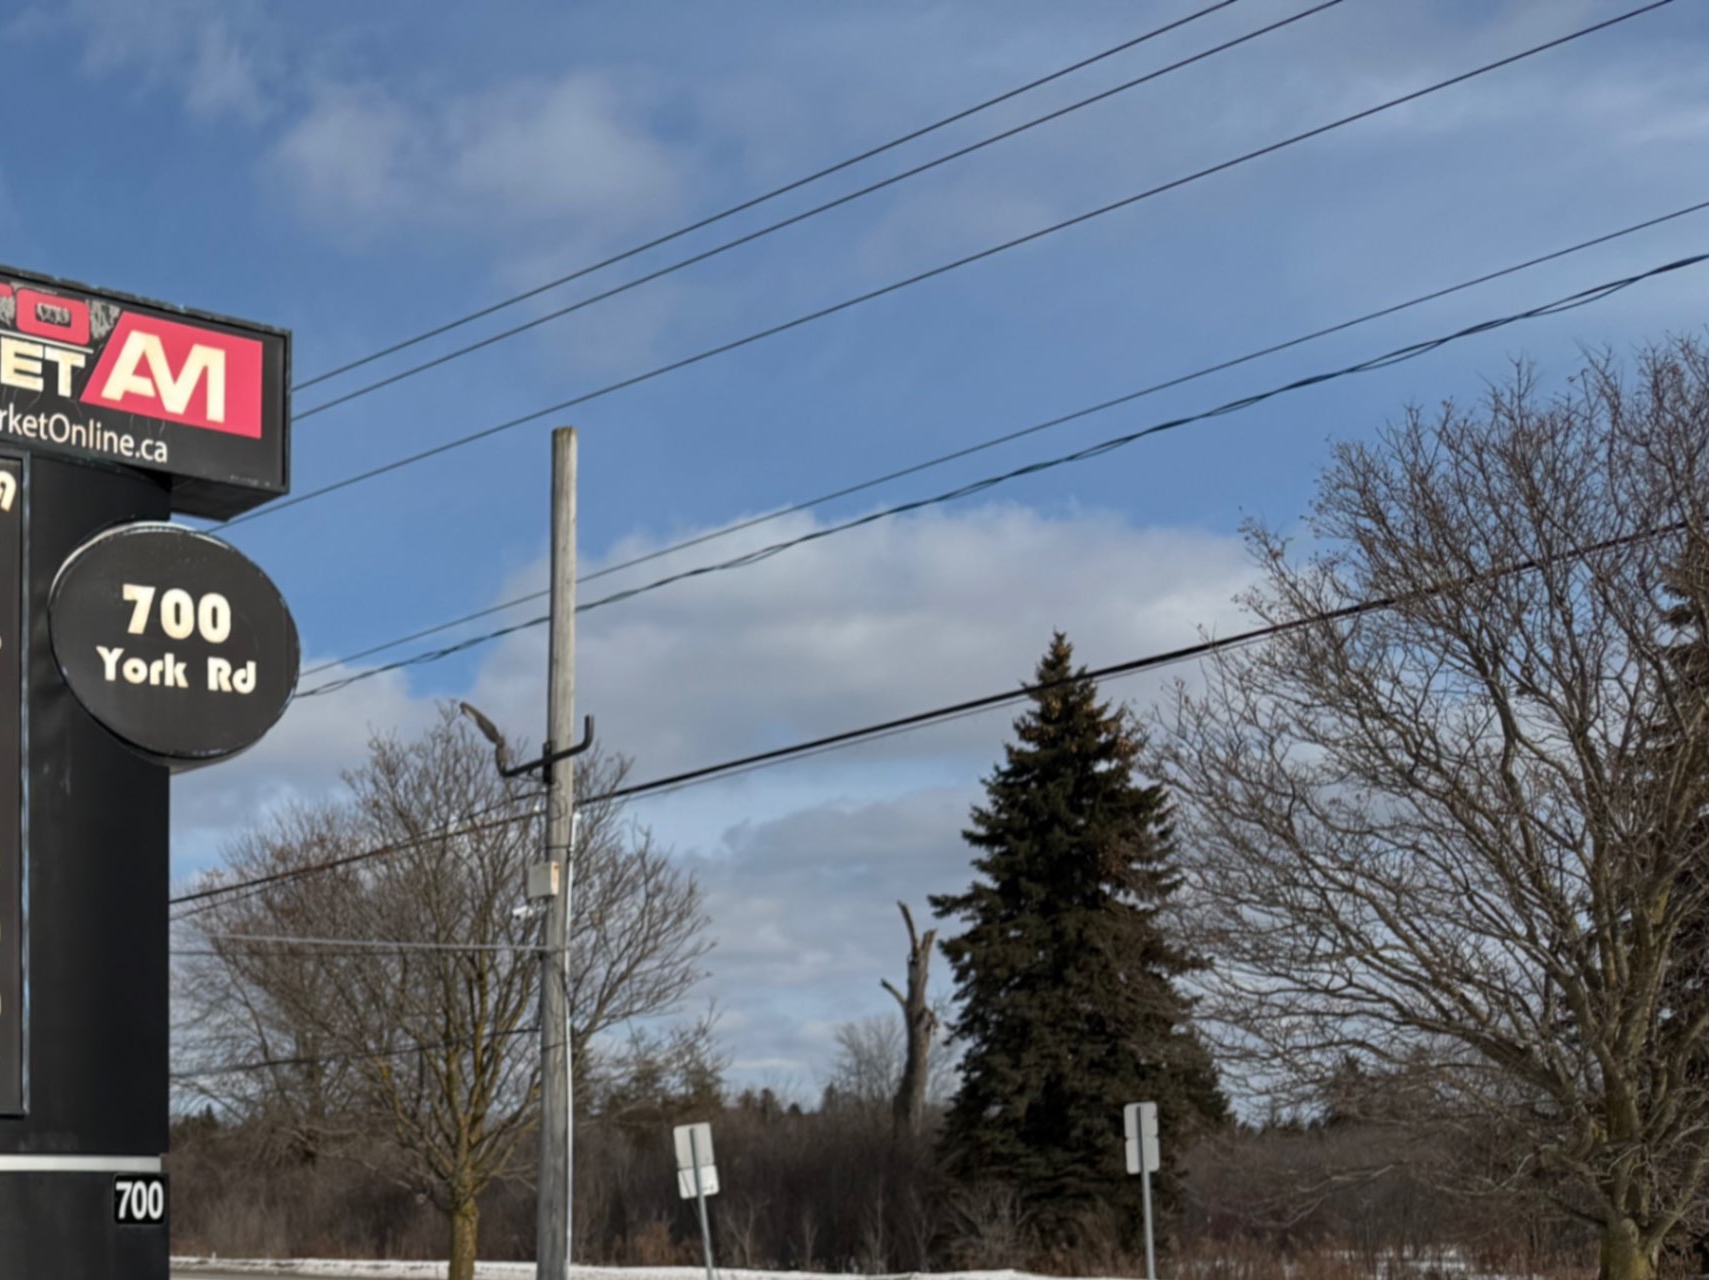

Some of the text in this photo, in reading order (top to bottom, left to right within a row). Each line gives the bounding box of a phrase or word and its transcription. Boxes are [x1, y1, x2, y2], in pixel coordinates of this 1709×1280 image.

[101, 330, 226, 424] AM
[122, 583, 232, 644] 700
[96, 646, 257, 694] York Rd
[116, 1181, 164, 1220] 700
